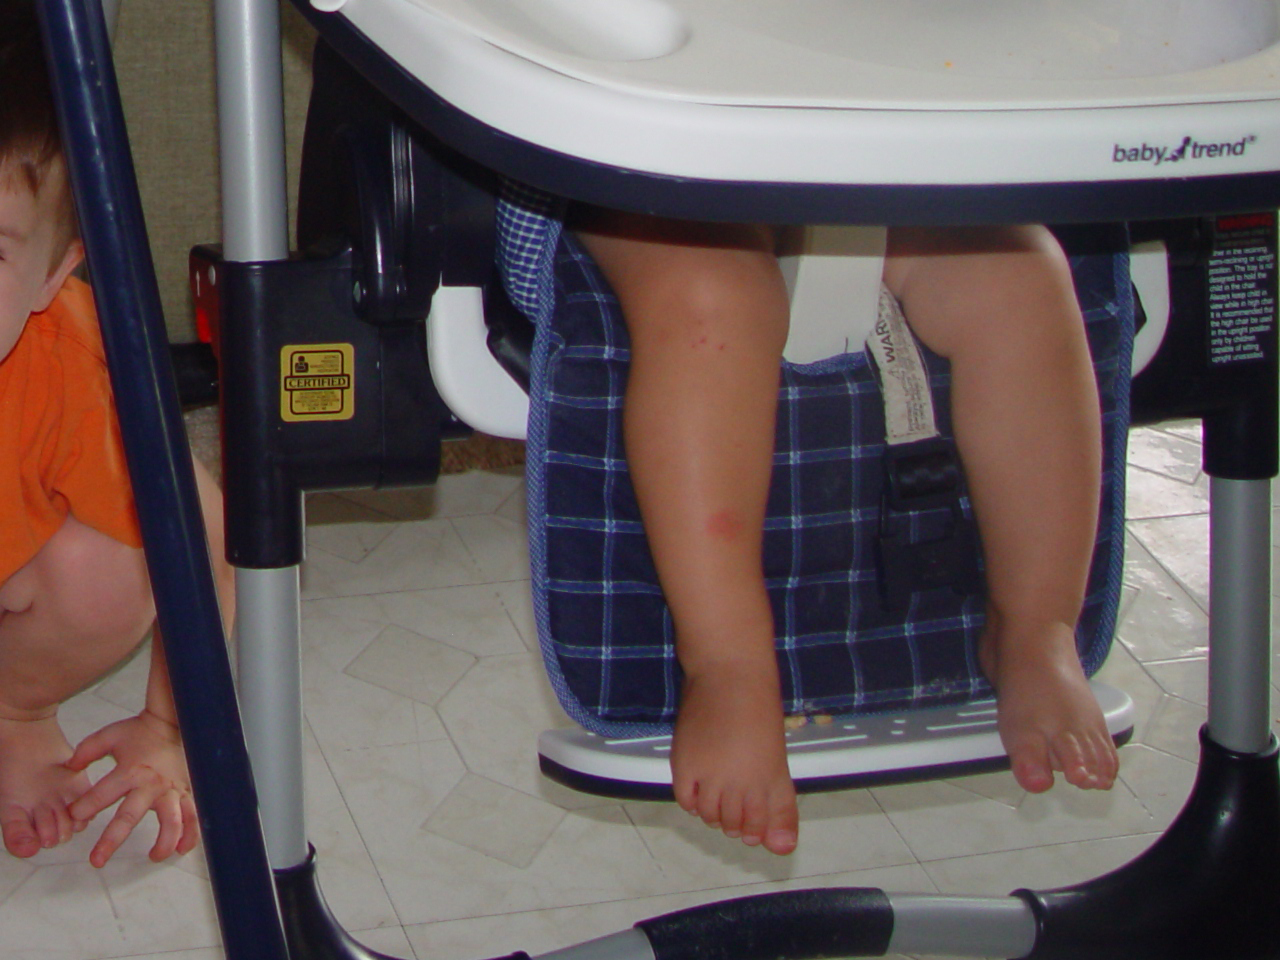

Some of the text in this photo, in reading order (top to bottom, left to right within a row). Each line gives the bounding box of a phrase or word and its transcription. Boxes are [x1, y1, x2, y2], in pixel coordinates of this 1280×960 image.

[1112, 137, 1246, 166] baby trend
[288, 377, 346, 388] CERTIFIED
